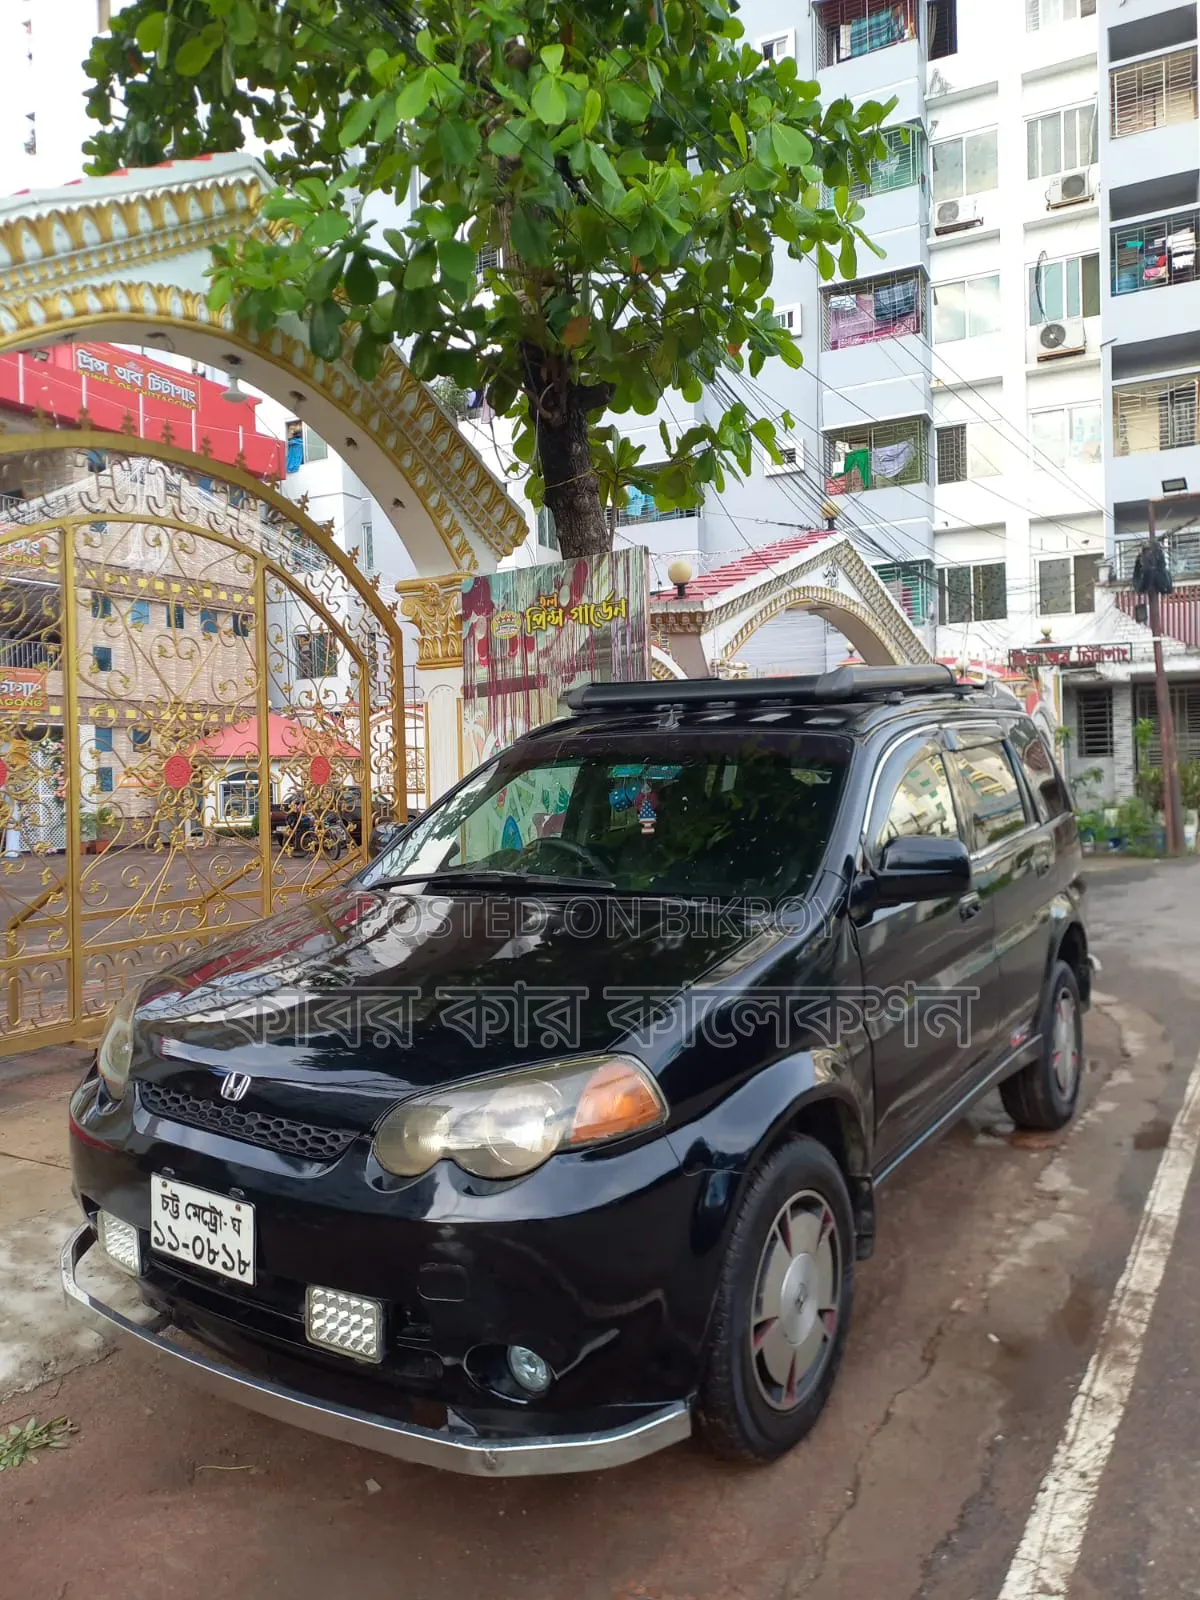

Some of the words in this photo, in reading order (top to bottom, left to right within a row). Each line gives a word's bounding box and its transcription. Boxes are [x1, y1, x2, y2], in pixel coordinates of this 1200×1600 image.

[76, 349, 109, 376] প্রিন্স
[114, 365, 144, 386] অব
[147, 373, 197, 404] চিটাগাং
[134, 388, 196, 409] CHITTAGONG
[525, 604, 564, 634] প্রিন্স
[570, 589, 628, 628] গার্ডেন
[160, 1189, 180, 1220] চট্ট
[153, 1220, 251, 1276] ১১-০৮১৮
